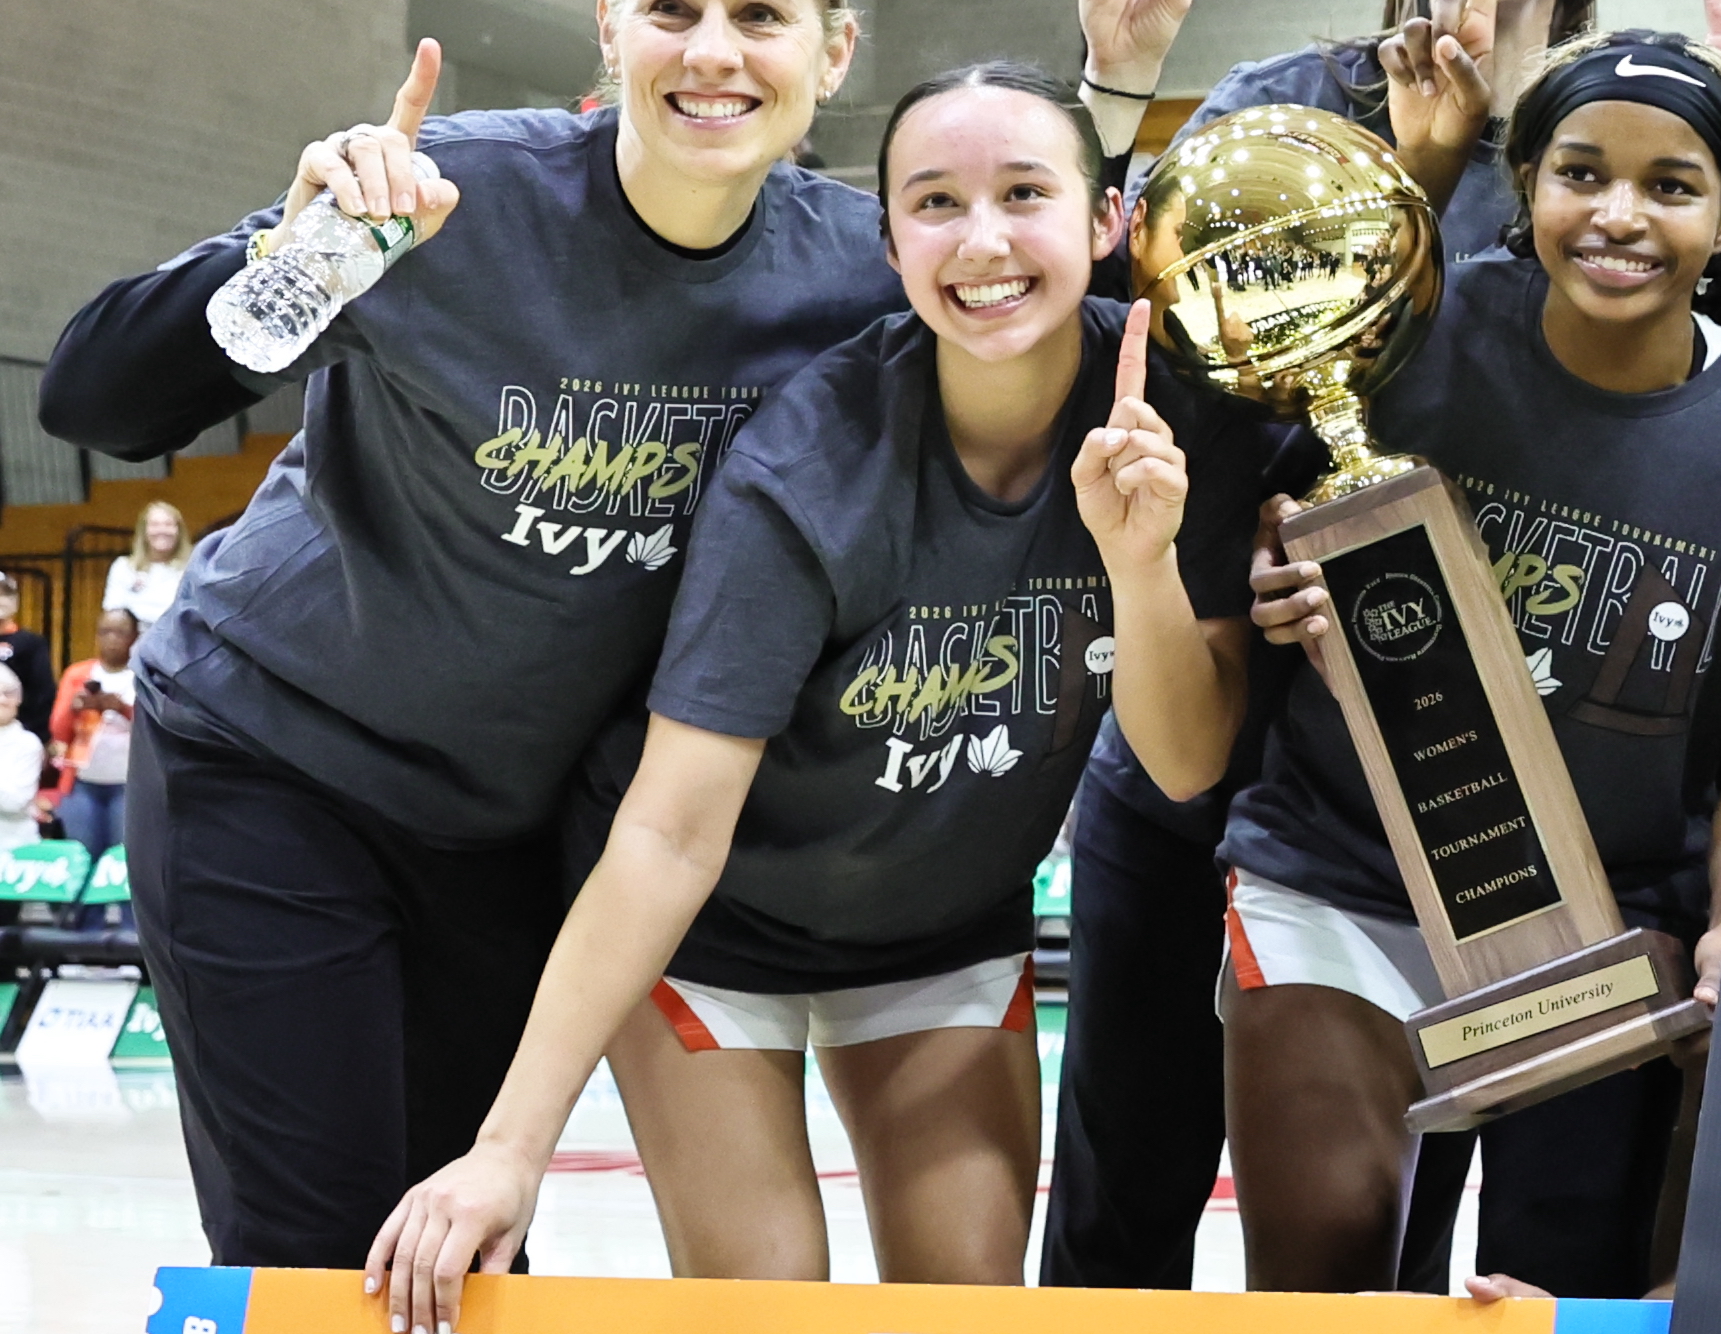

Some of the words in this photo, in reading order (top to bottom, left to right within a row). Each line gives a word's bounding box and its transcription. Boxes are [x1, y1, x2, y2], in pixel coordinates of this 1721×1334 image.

[559, 377, 603, 393] 2026
[651, 385, 709, 398] LEAGUE
[474, 427, 702, 500] CHAMPS
[1540, 499, 1601, 527] LEAGUE
[500, 503, 628, 576] Ivy
[1381, 598, 1426, 630] IVY
[1413, 690, 1444, 711] 2026
[1412, 729, 1479, 763] WOMEN'S
[1417, 772, 1509, 815] BASKETBALL
[1430, 815, 1528, 862] TOURNAMENT
[1454, 865, 1538, 906] CHAMPIONS
[1461, 1003, 1534, 1042] Princeton
[1536, 979, 1615, 1020] University
